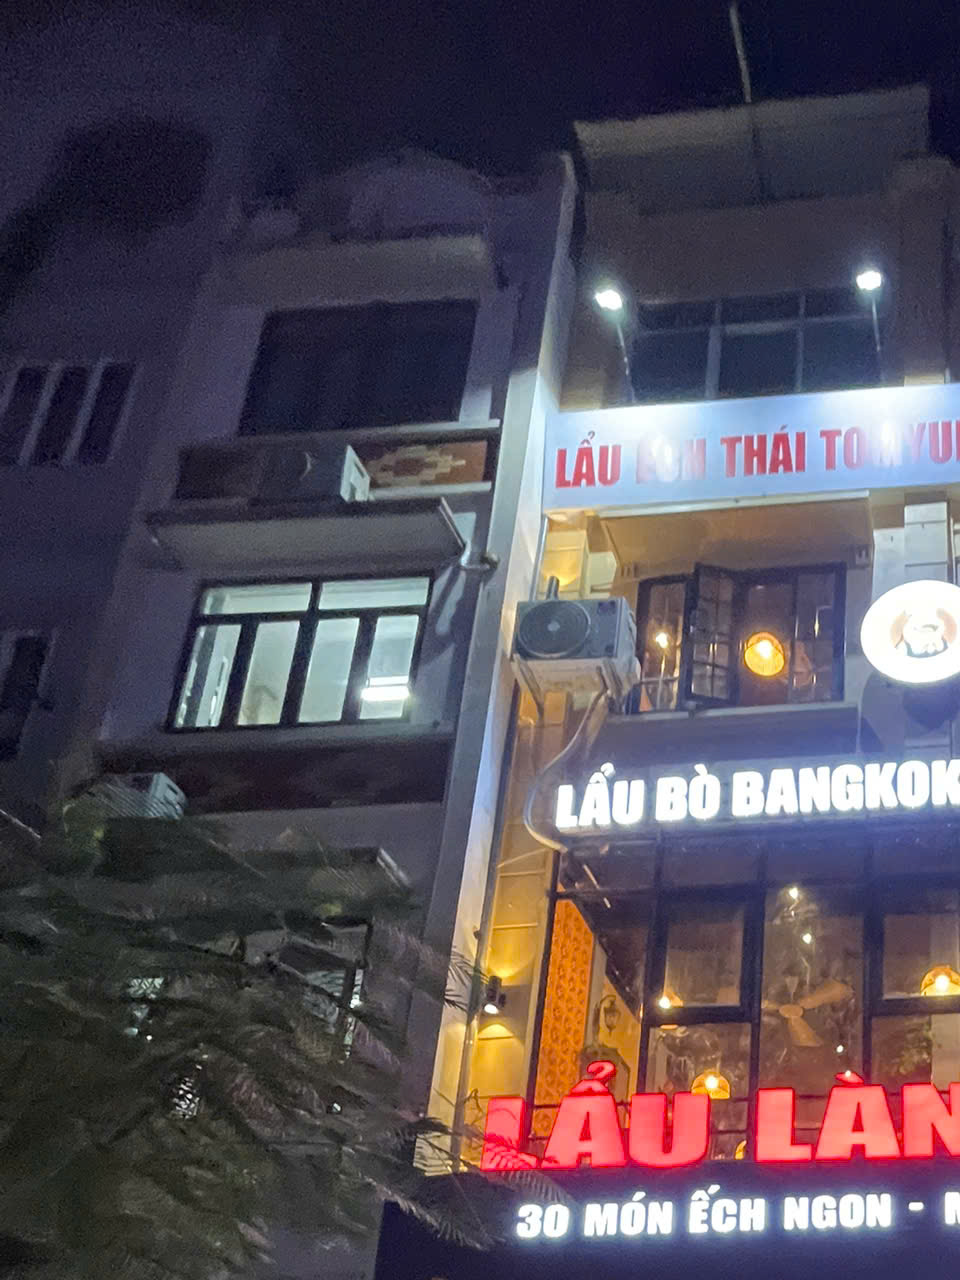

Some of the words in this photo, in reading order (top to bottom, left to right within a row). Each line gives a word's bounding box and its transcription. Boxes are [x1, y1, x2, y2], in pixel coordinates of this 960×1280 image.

[555, 431, 622, 488] LẨU
[720, 425, 806, 477] THÁI
[556, 763, 646, 828] LẨU
[656, 764, 721, 821] BÒ
[481, 1060, 711, 1171] LẨU
[516, 1203, 569, 1238] 30
[584, 1191, 673, 1237] MÓN
[688, 1185, 765, 1234] ẾCH
[783, 1193, 892, 1229] NGON
